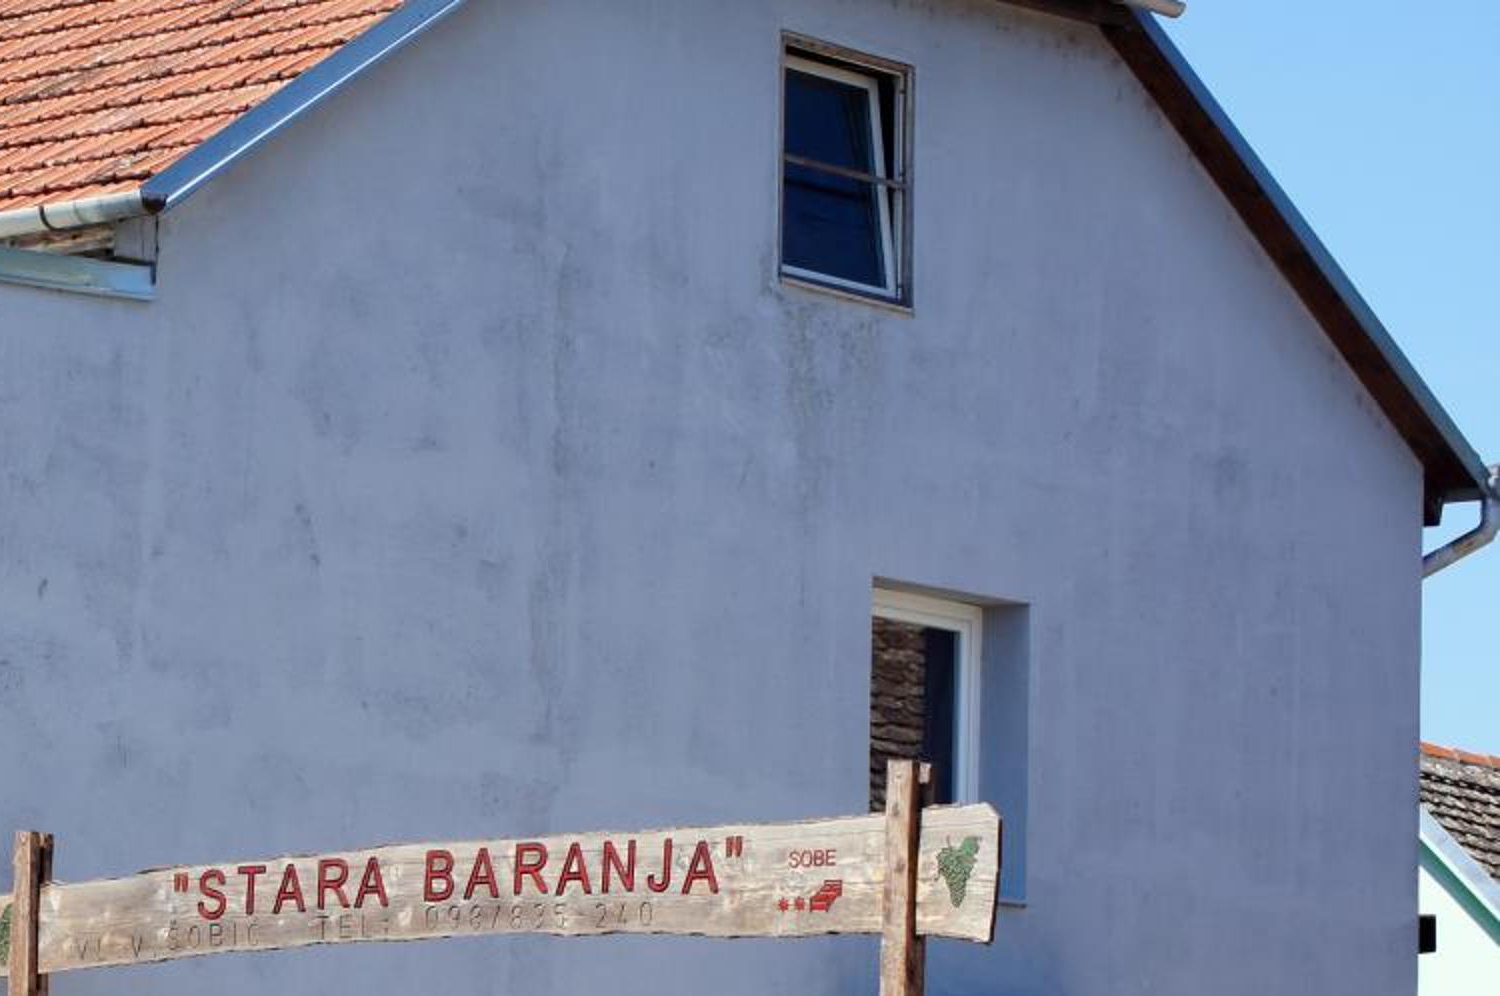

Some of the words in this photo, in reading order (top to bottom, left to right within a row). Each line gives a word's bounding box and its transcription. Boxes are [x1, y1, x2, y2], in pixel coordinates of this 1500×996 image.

[173, 857, 389, 921] "STARA
[422, 836, 744, 902] BARANJA"
[787, 849, 837, 869] SOBE
